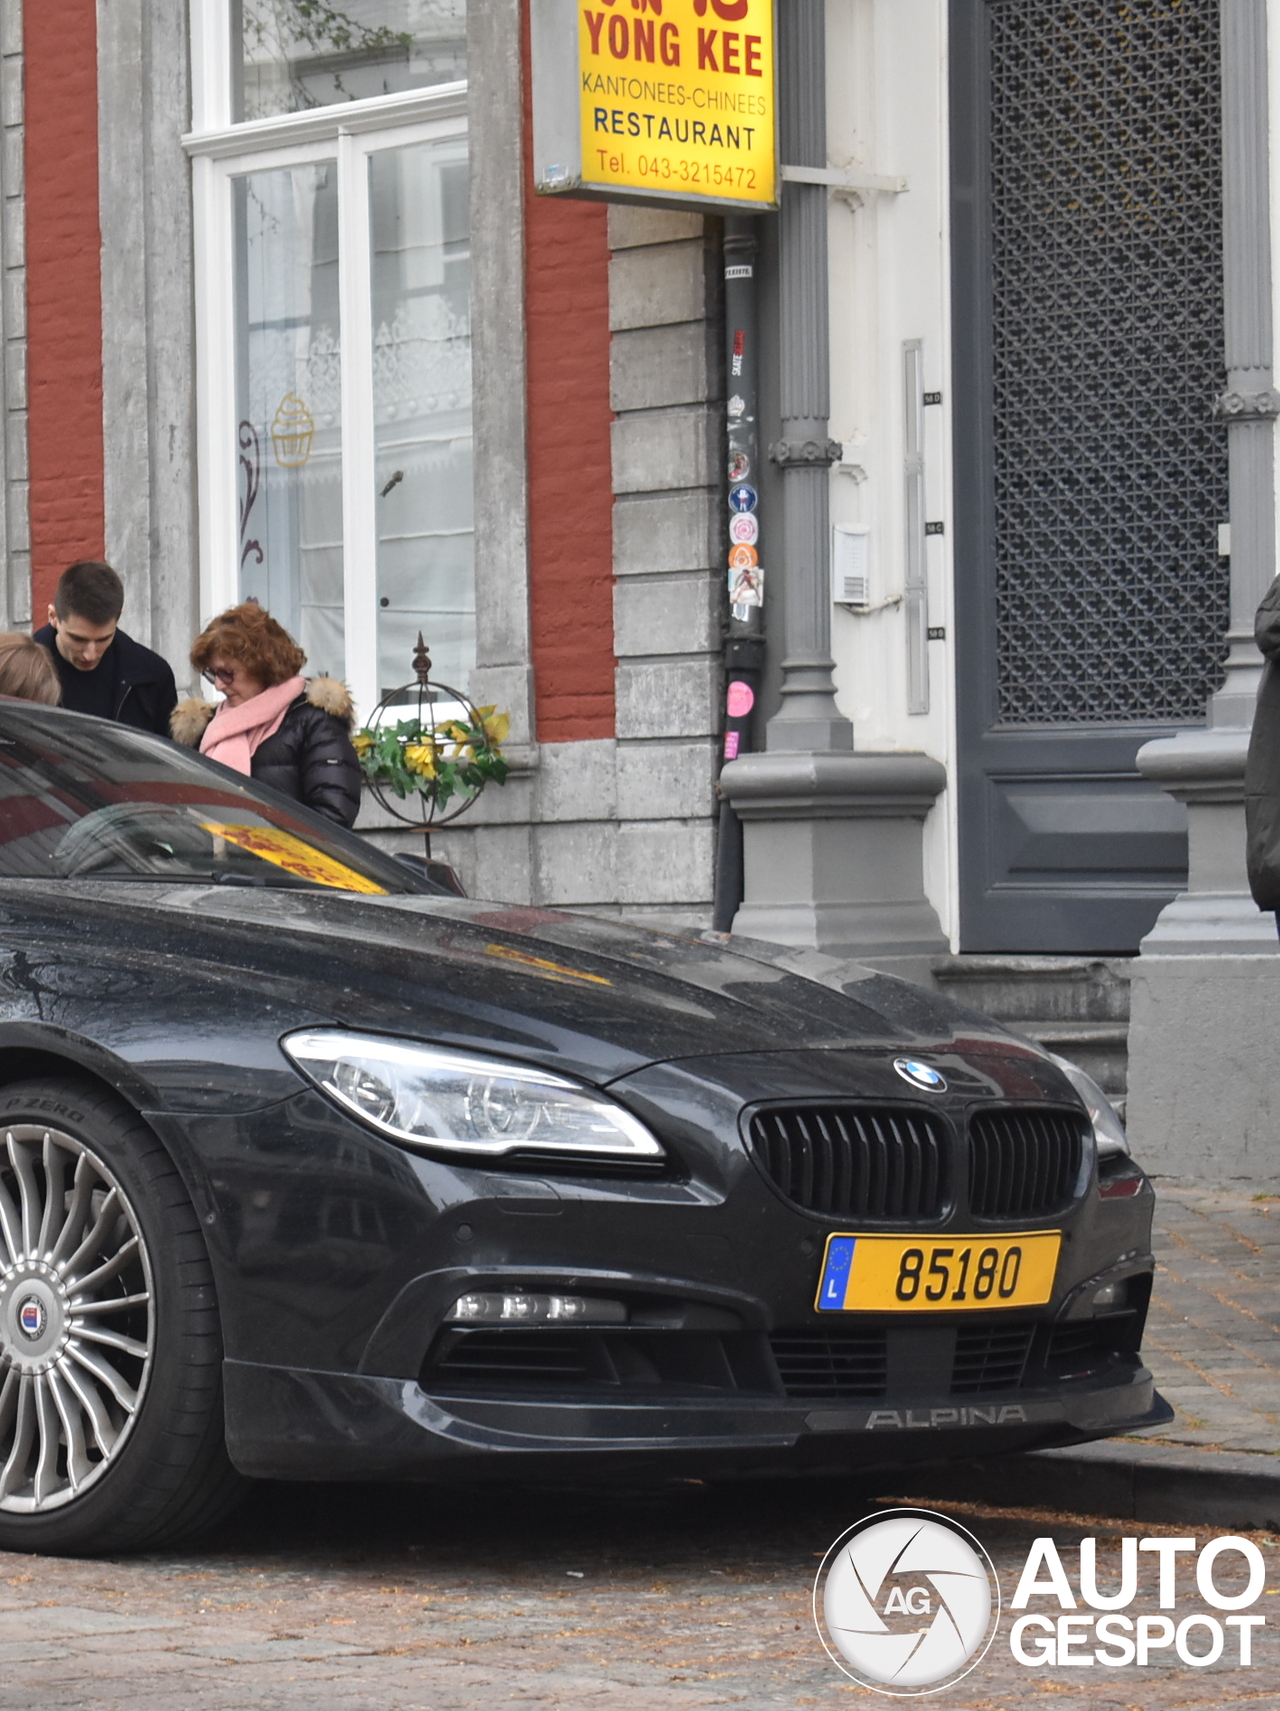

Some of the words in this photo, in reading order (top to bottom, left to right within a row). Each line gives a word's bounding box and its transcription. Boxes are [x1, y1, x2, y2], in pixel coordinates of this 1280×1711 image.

[583, 9, 681, 68] YONG
[697, 26, 763, 78] KEE
[582, 71, 766, 116] KANTONEES-CHINEES
[594, 107, 755, 151] RESTAURANT
[596, 149, 630, 175] Tel.
[637, 154, 757, 190] 043-3215472
[5, 1098, 21, 1110] P
[23, 1098, 86, 1122] ZERO
[827, 1279, 837, 1298] L
[895, 1245, 1022, 1302] 85180
[865, 1404, 1027, 1430] ALPINA
